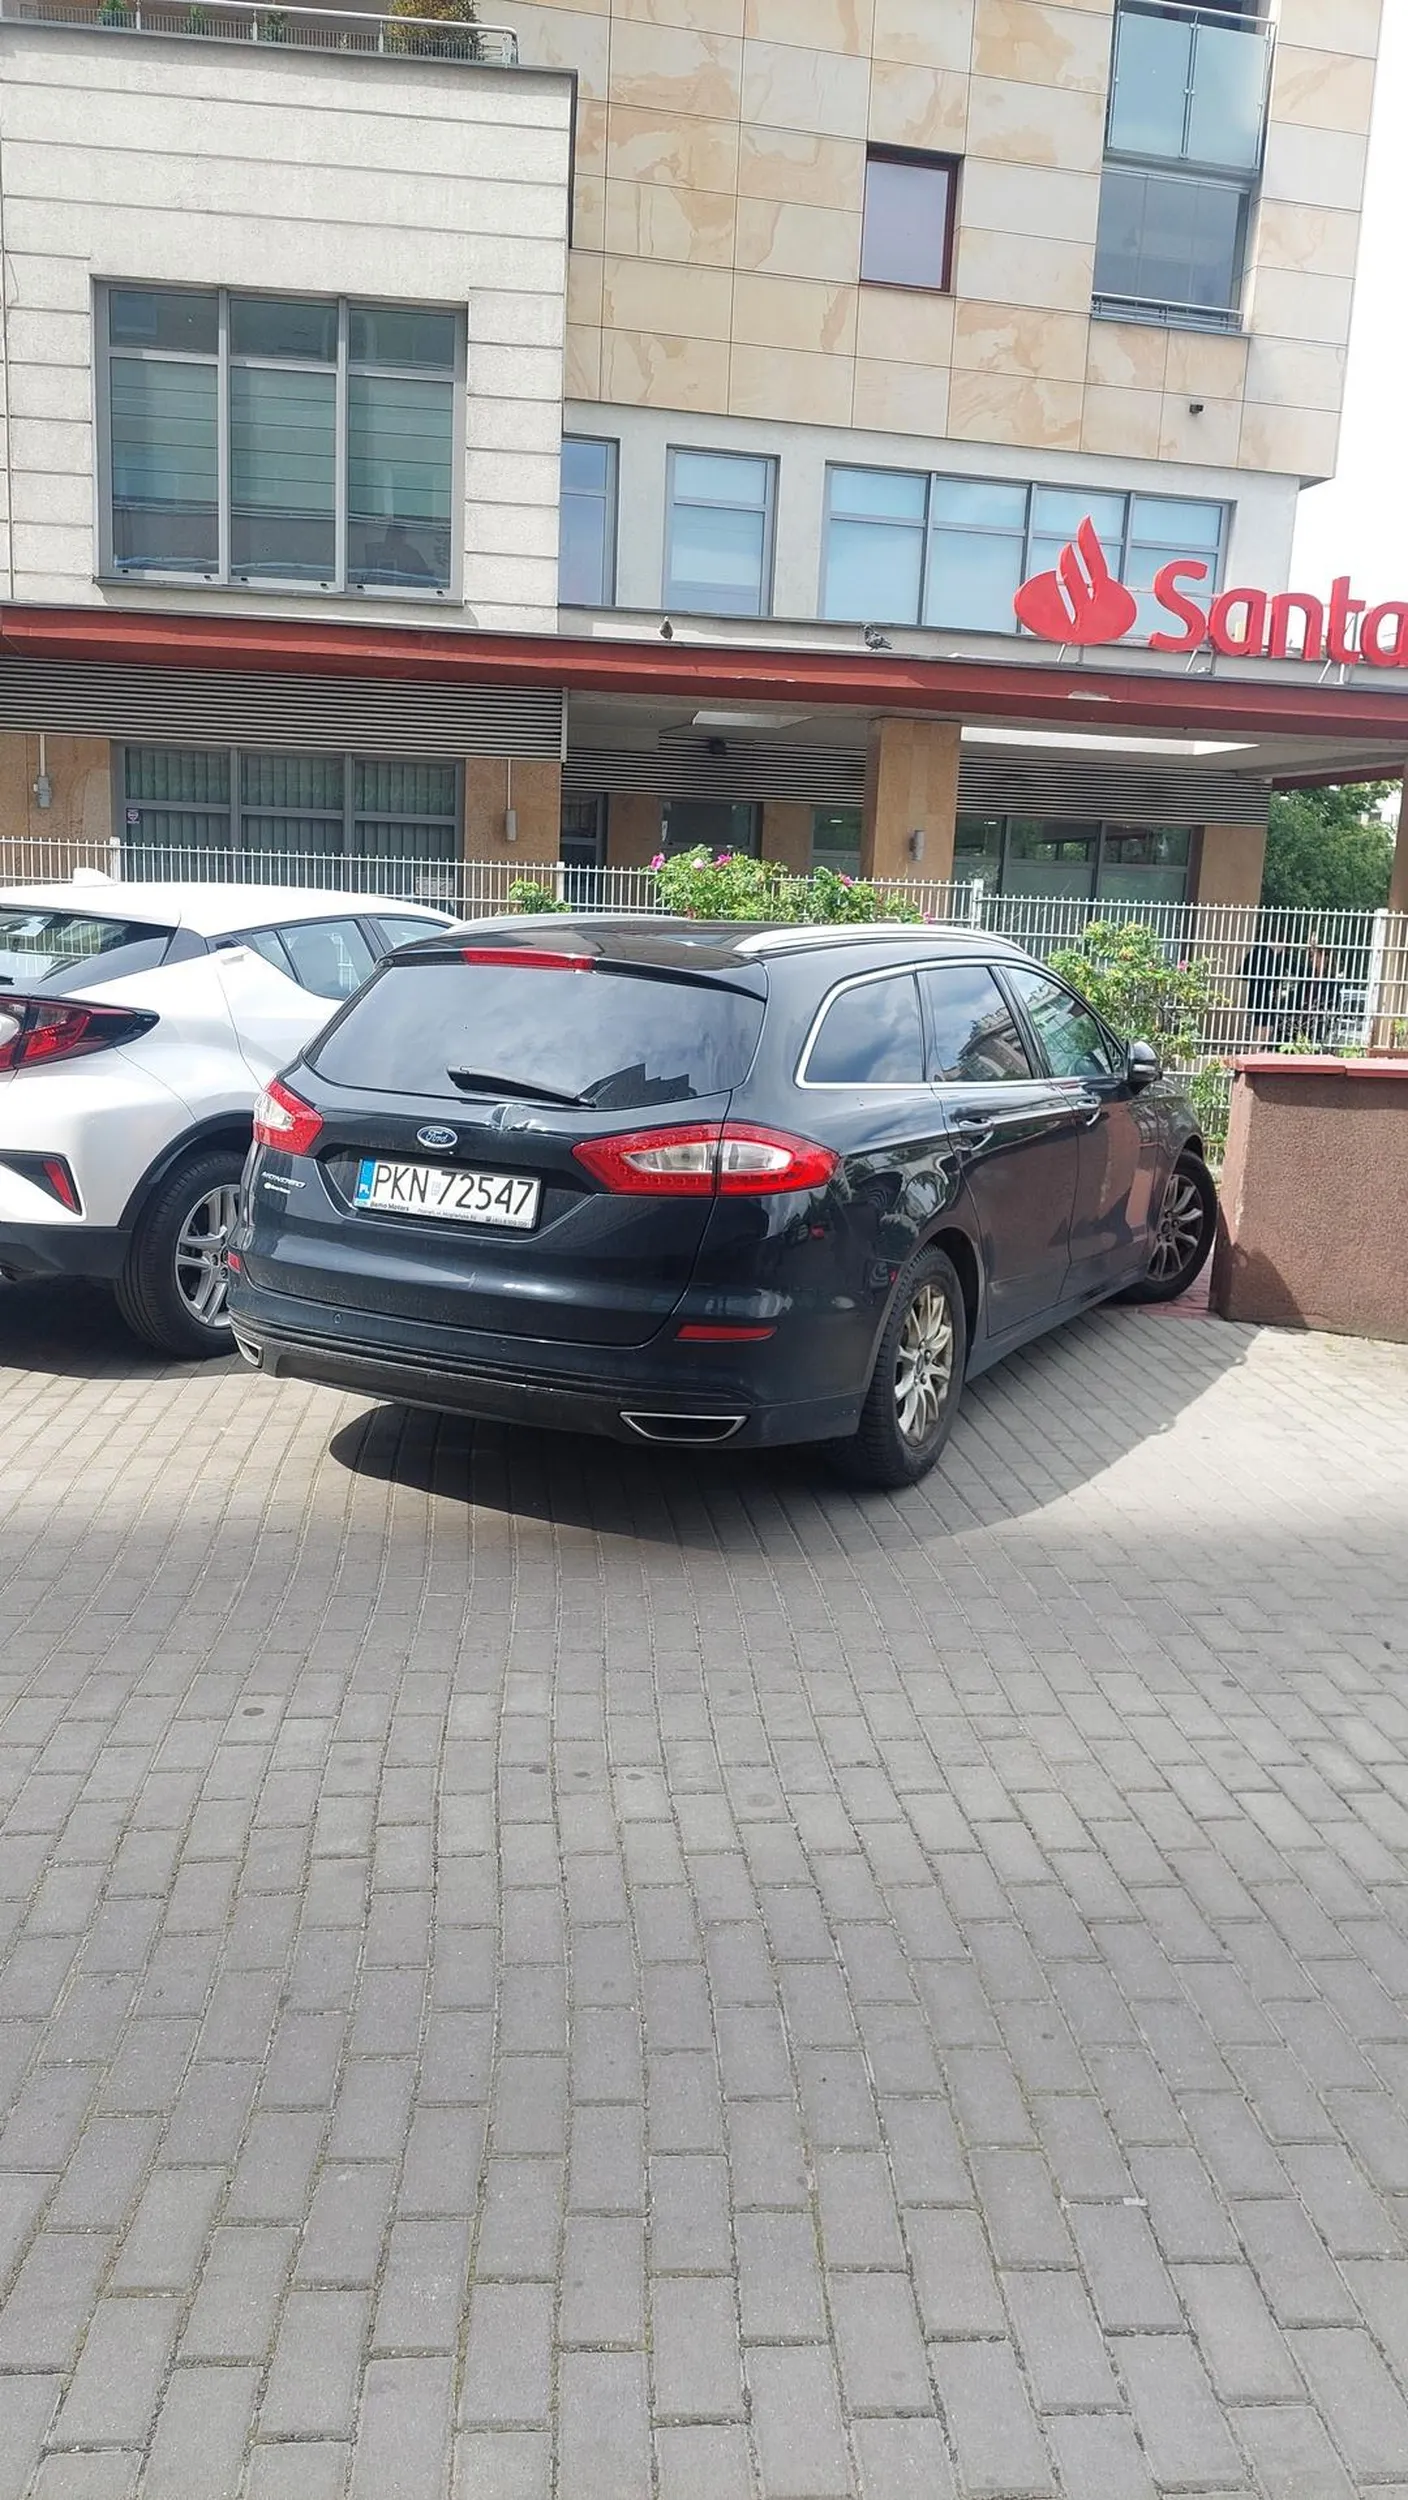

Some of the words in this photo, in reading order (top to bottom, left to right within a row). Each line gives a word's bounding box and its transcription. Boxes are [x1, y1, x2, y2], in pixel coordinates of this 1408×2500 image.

[1149, 559, 1408, 668] Santa
[373, 1164, 429, 1203] PKN
[437, 1170, 534, 1215] 72547
